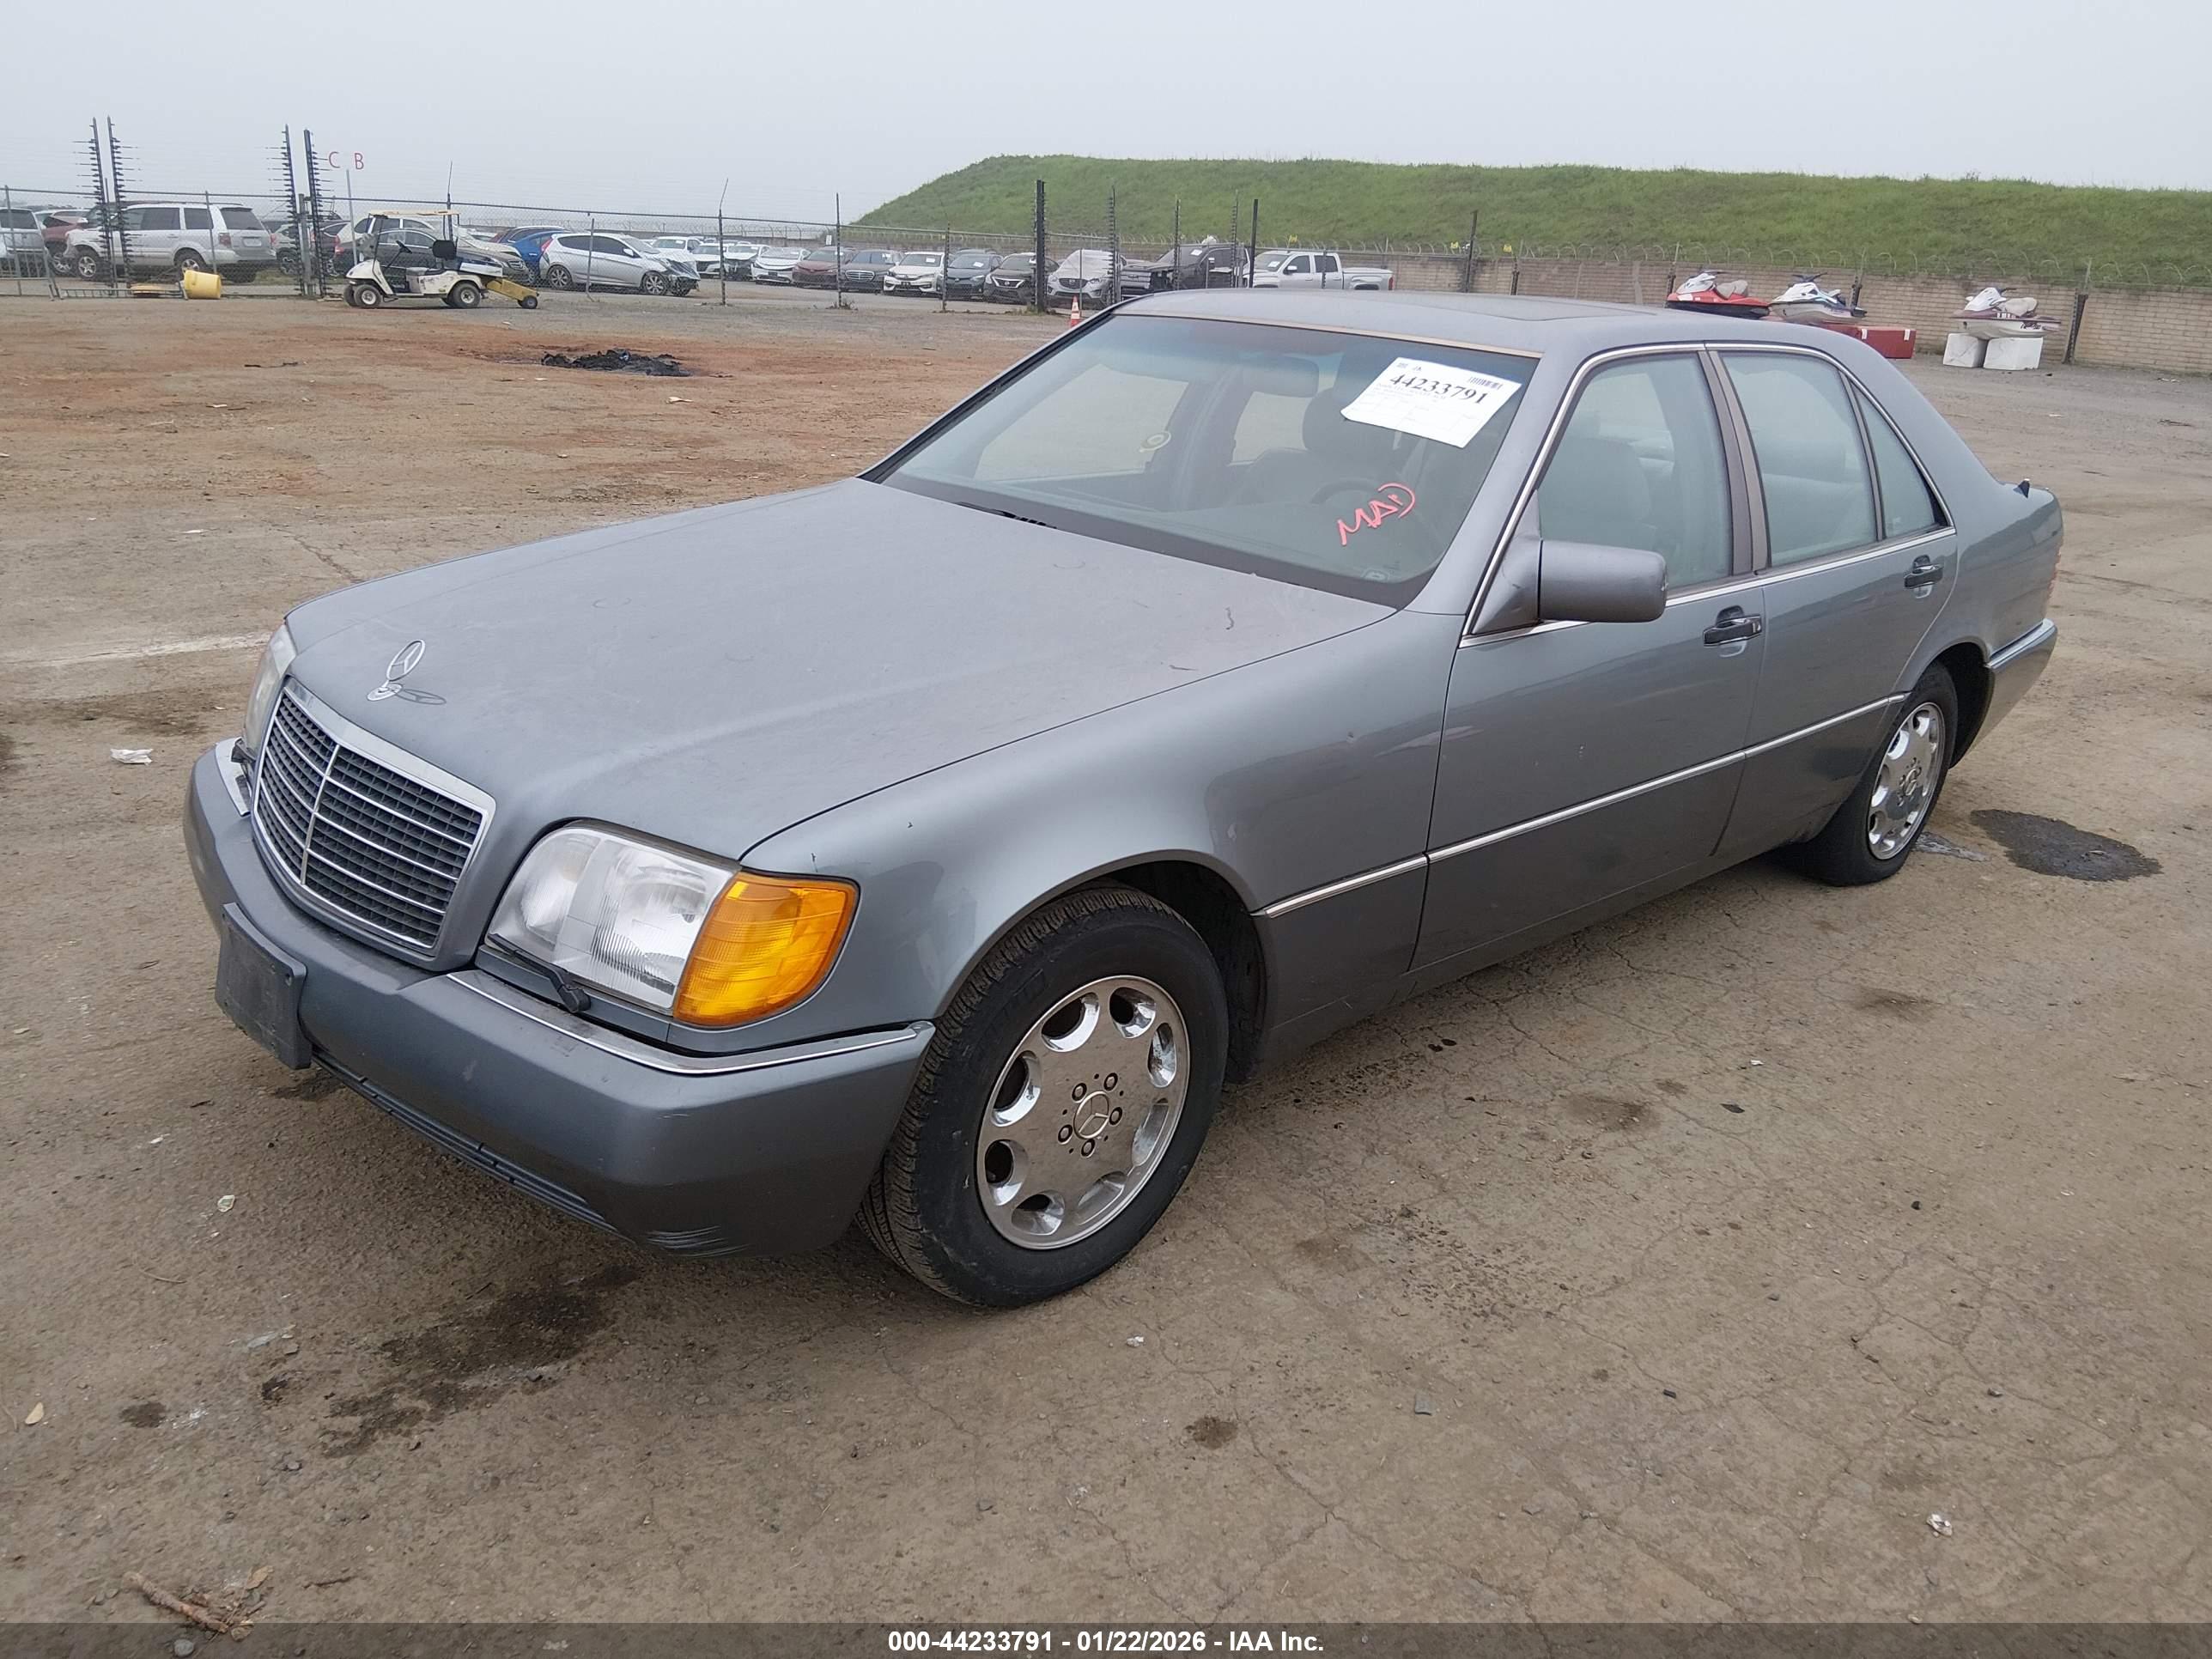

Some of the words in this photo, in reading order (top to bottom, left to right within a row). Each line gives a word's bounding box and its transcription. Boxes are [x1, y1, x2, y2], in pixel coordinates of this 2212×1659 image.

[328, 151, 341, 168] C
[354, 152, 364, 170] B
[1389, 373, 1489, 404] 44233791
